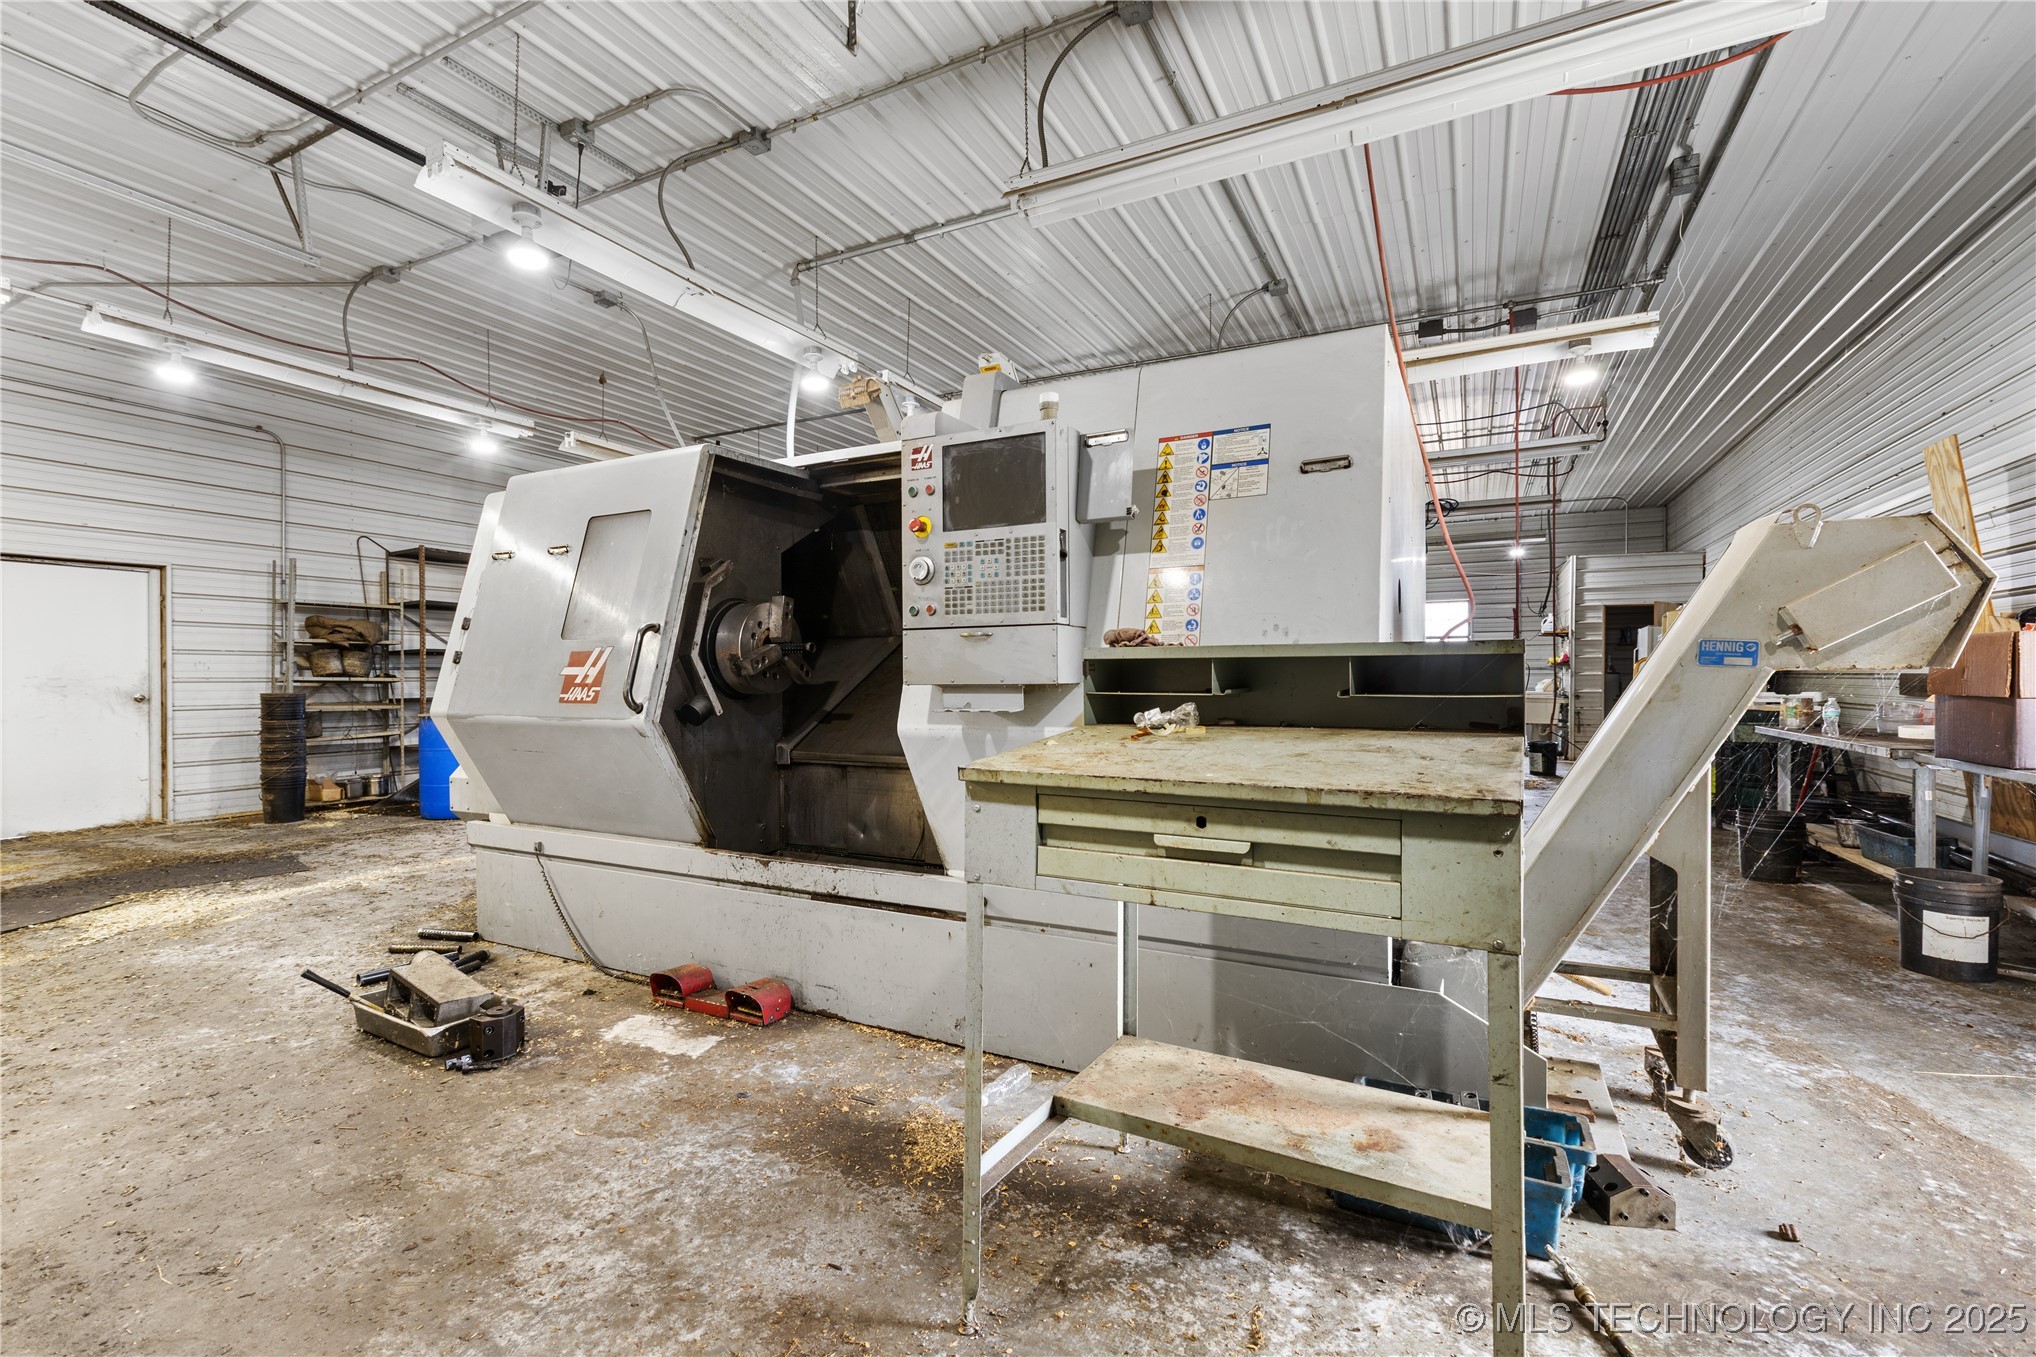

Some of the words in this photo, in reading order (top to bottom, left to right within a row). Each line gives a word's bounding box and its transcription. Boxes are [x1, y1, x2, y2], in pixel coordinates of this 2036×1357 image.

[911, 460, 933, 470] HAAS
[1702, 641, 1744, 652] HENNIG
[559, 686, 601, 701] HAAS
